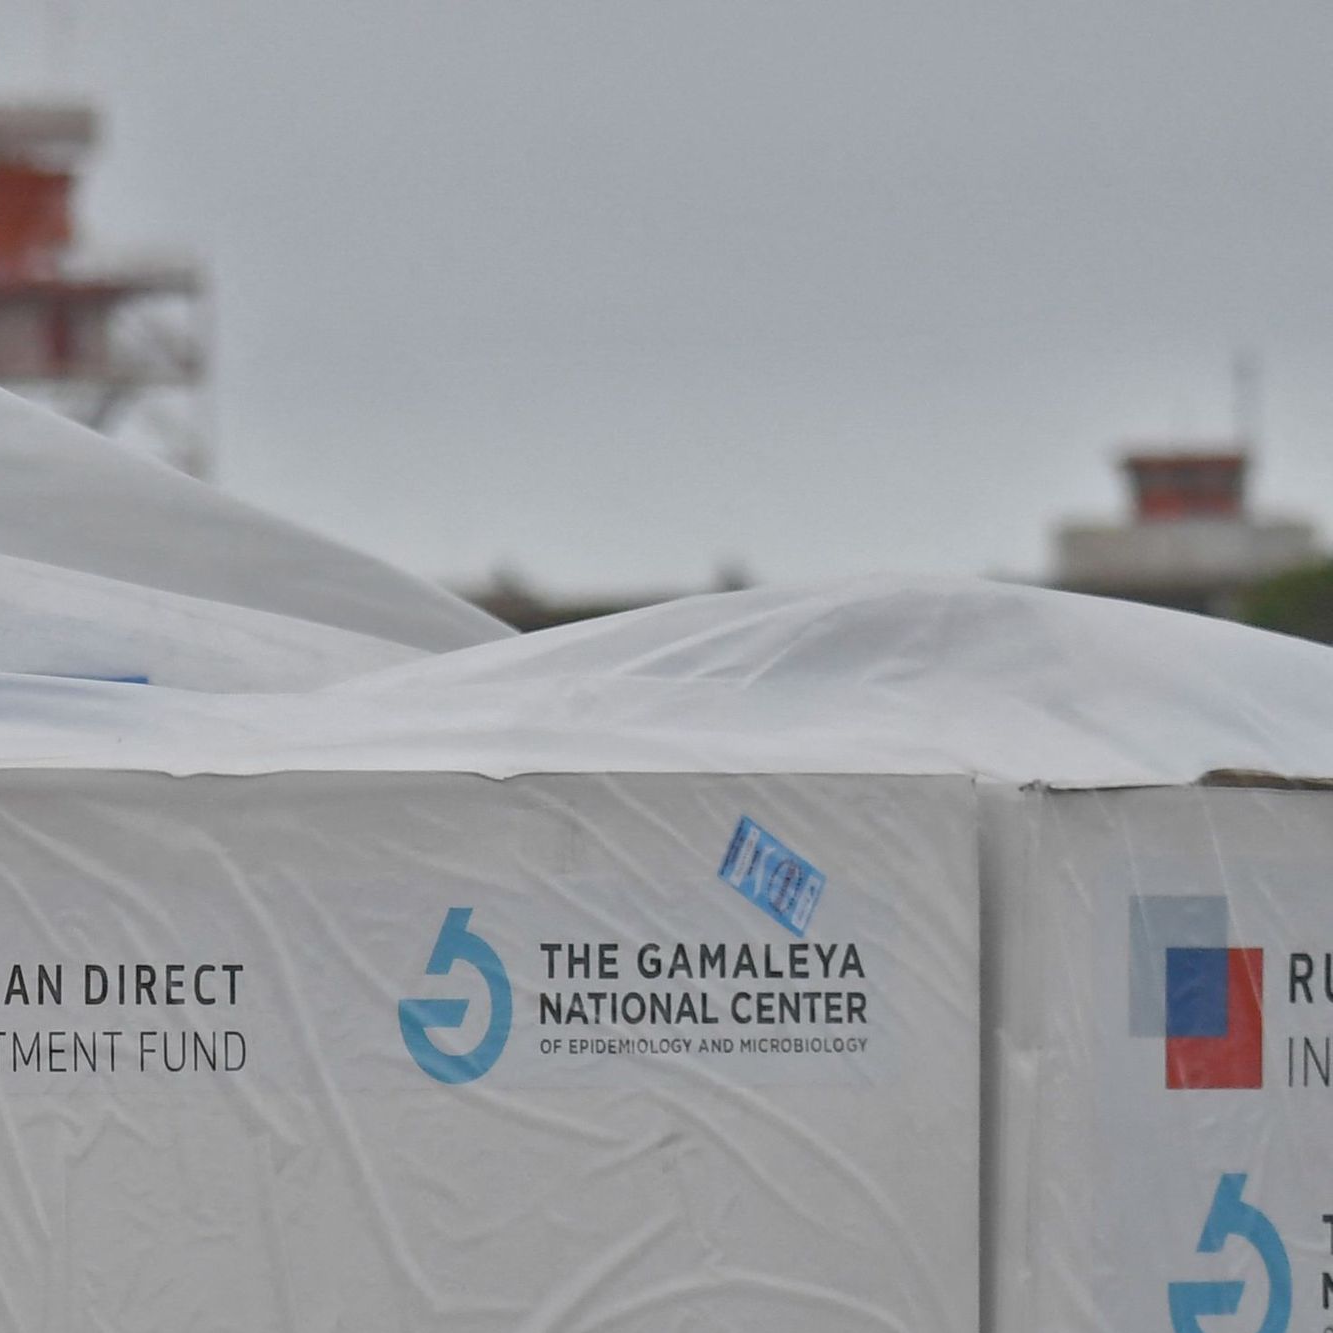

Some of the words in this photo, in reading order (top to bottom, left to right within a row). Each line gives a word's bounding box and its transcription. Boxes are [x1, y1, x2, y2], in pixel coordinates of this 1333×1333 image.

[540, 943, 620, 980] THE
[636, 943, 866, 980] GAMALEYA
[84, 963, 245, 1006] DIRECT
[539, 992, 719, 1025] NATIONAL
[730, 992, 868, 1025] CENTER
[139, 1031, 248, 1073] FUND
[540, 1039, 562, 1055] OF
[568, 1038, 692, 1055] EPIDEMIOLOGY
[698, 1038, 734, 1054] AND
[739, 1037, 869, 1054] MICROBIOLOGY
